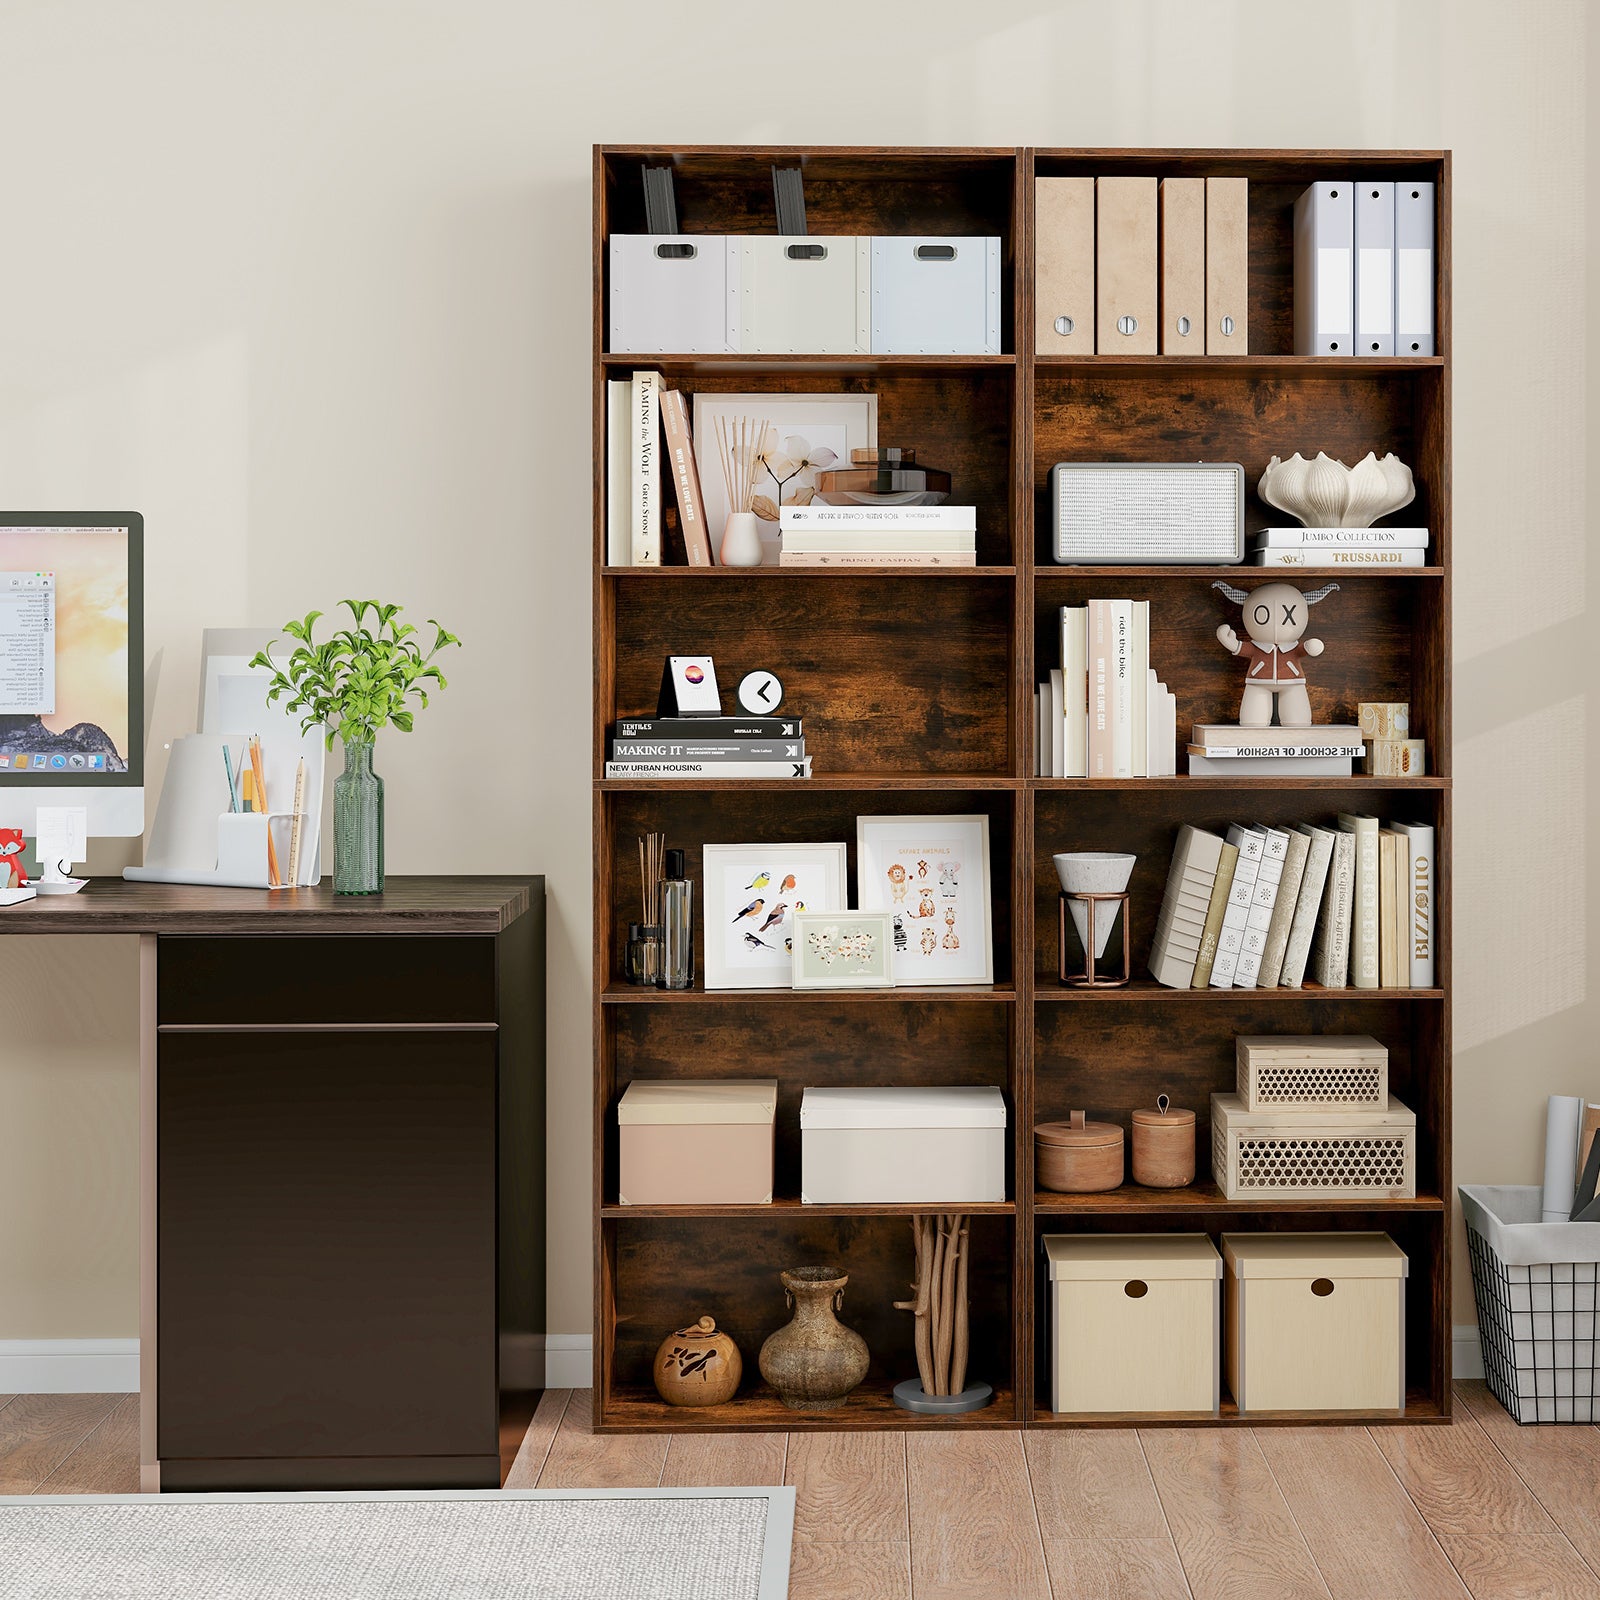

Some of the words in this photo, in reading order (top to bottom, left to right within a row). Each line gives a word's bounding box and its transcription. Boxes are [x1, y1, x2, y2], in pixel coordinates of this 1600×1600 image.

[641, 378, 652, 425] TAMING
[641, 427, 650, 441] the
[641, 442, 652, 476] WOLF
[675, 448, 685, 463] WHY
[678, 465, 687, 474] DO
[680, 475, 689, 487] WE
[642, 483, 650, 507] GREG
[682, 487, 692, 504] LOVE
[685, 504, 695, 521] CATS
[642, 509, 650, 536] STONE
[1300, 531, 1334, 542] JUMBO
[1336, 531, 1396, 542] COLLECTION
[1332, 552, 1403, 563] TRUSSARDI
[1118, 616, 1126, 636] ride
[1118, 638, 1126, 655] the
[1096, 657, 1105, 673] WHY
[1118, 657, 1126, 679] bike
[1096, 674, 1105, 684] DO
[1096, 684, 1105, 695] WE
[1096, 695, 1105, 713] LOVE
[1096, 713, 1105, 730] CATS
[616, 745, 667, 756] MAKING
[670, 745, 683, 756] IT
[1415, 855, 1430, 961] BIZZOTTO
